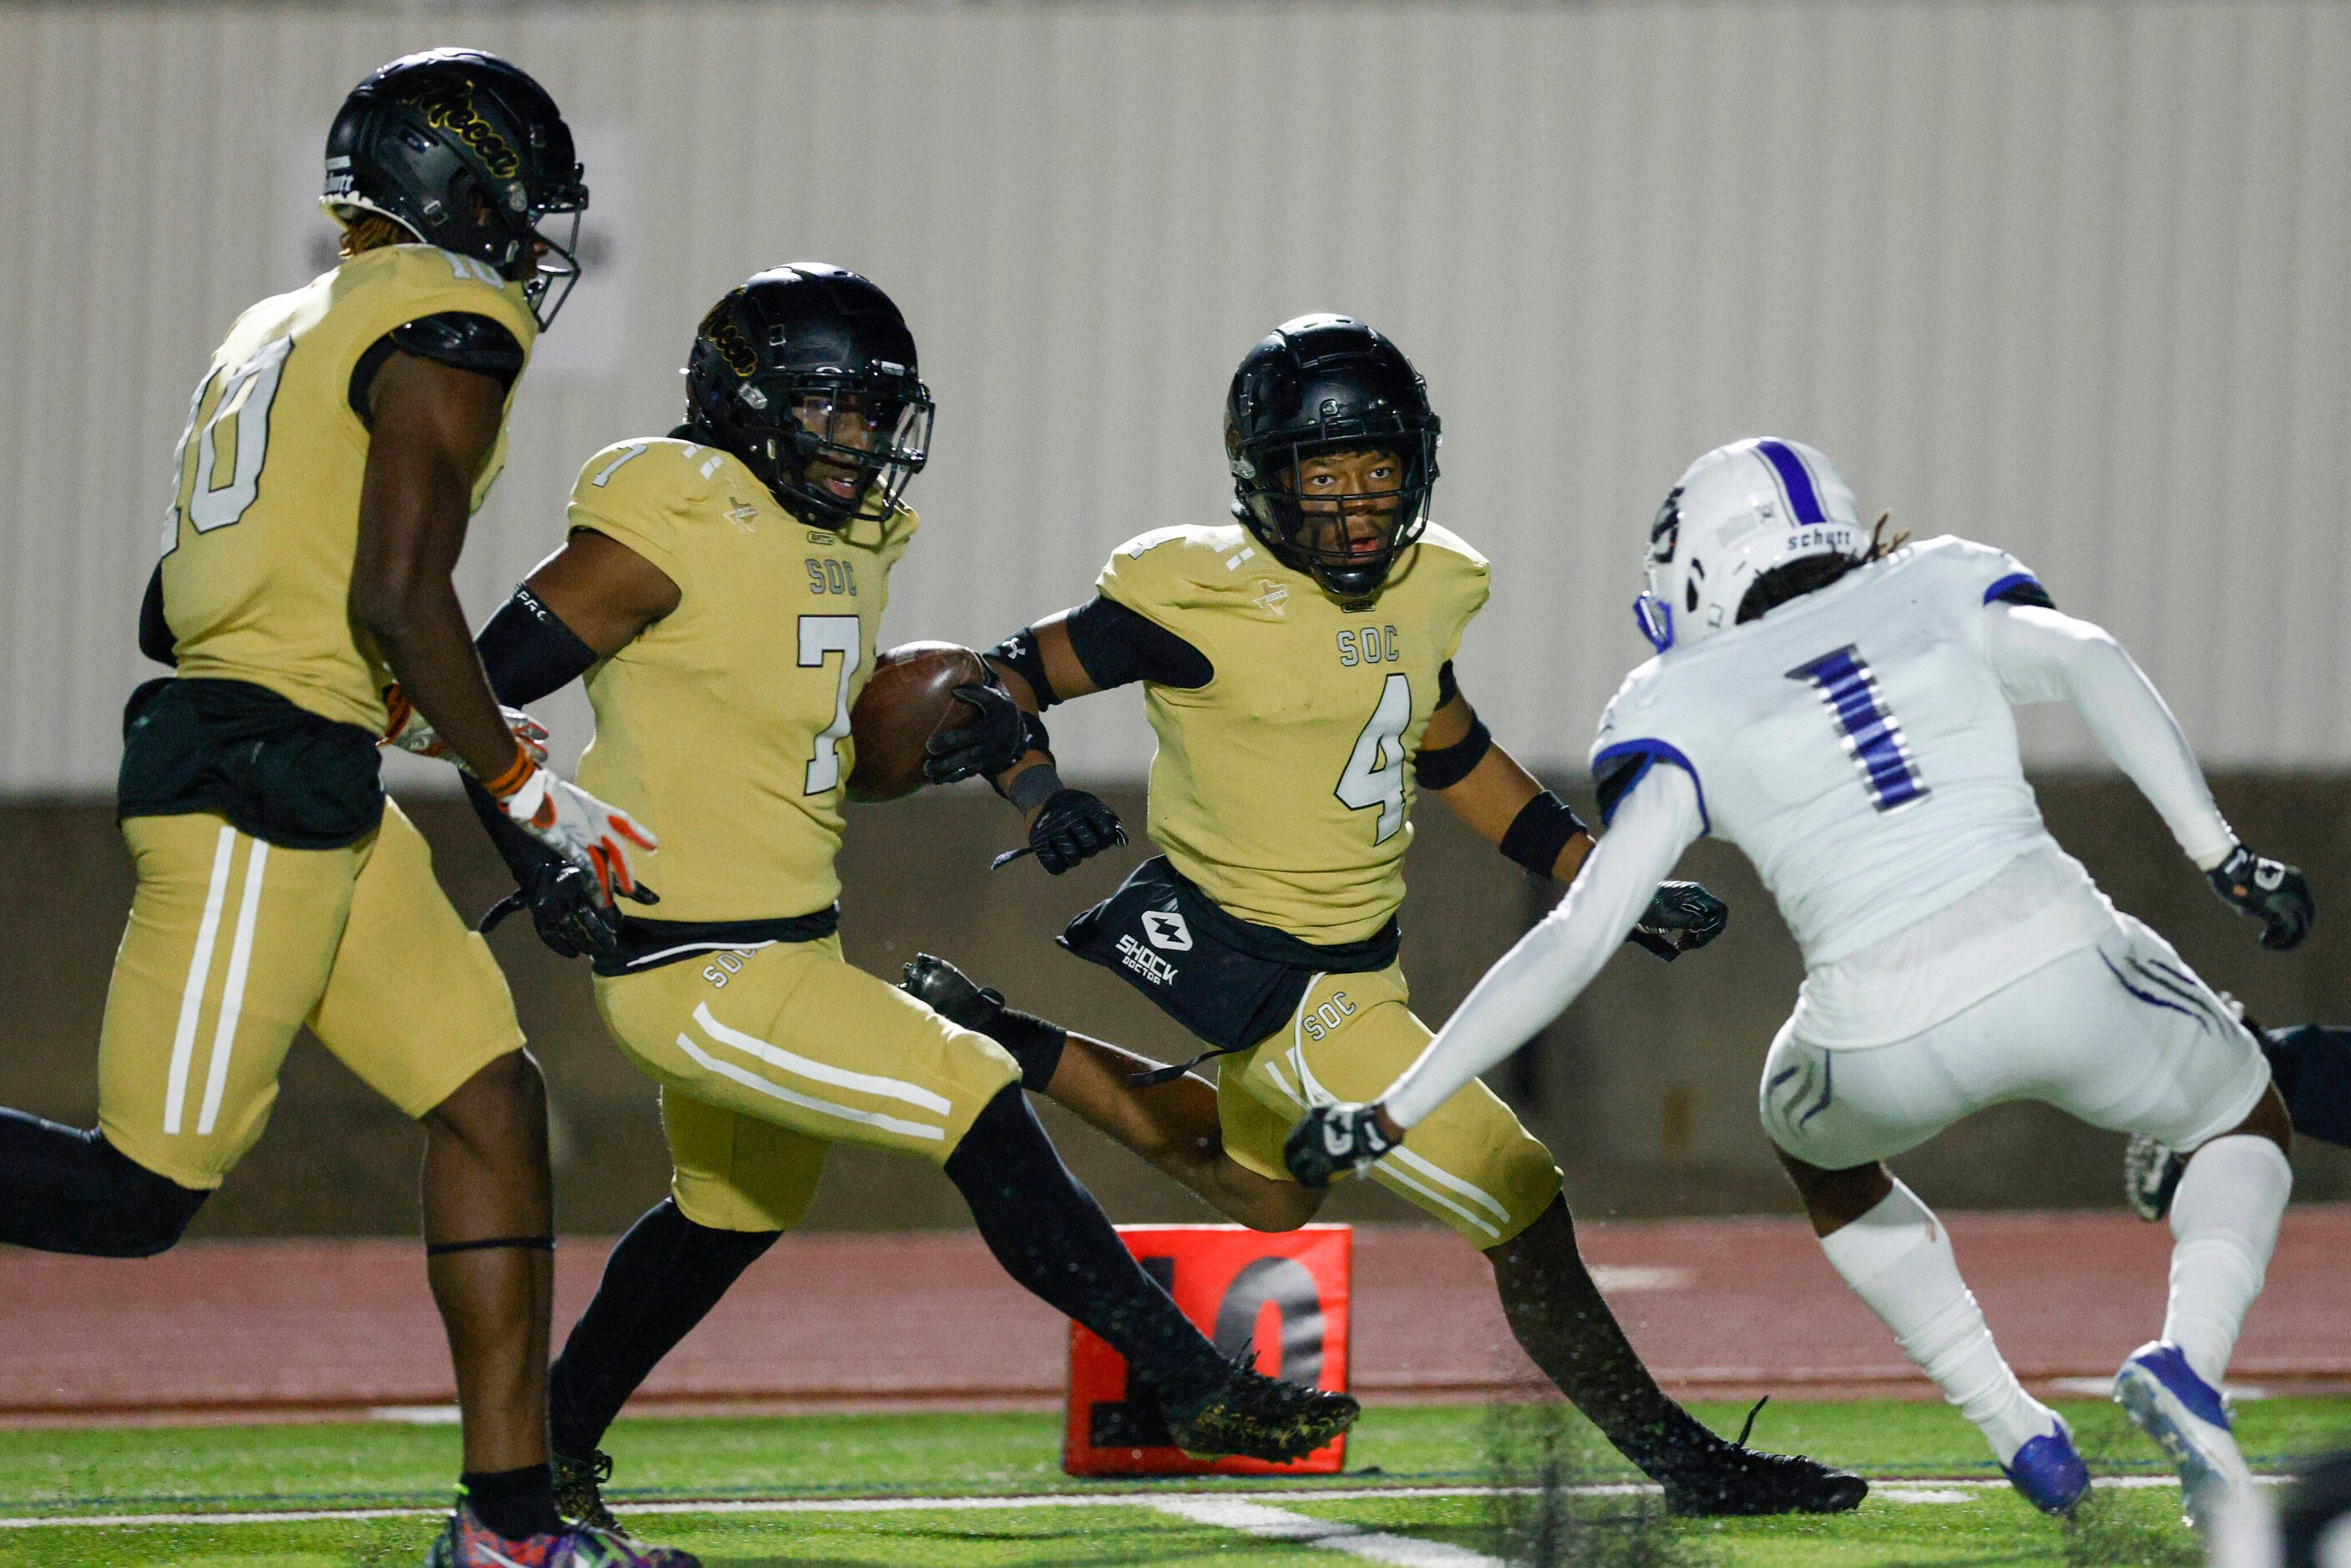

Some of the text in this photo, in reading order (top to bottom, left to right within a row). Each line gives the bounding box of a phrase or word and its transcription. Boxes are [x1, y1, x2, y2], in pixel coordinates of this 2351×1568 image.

[1787, 528, 1850, 551] schutt
[805, 559, 857, 596] SOC
[1337, 625, 1399, 666] SOC
[797, 615, 861, 797] 7
[1784, 641, 1932, 815] 1
[1333, 673, 1412, 847] 4
[1115, 933, 1179, 986] SHOCK
[1122, 955, 1161, 985] DOCTOR
[1302, 991, 1357, 1041] SOC
